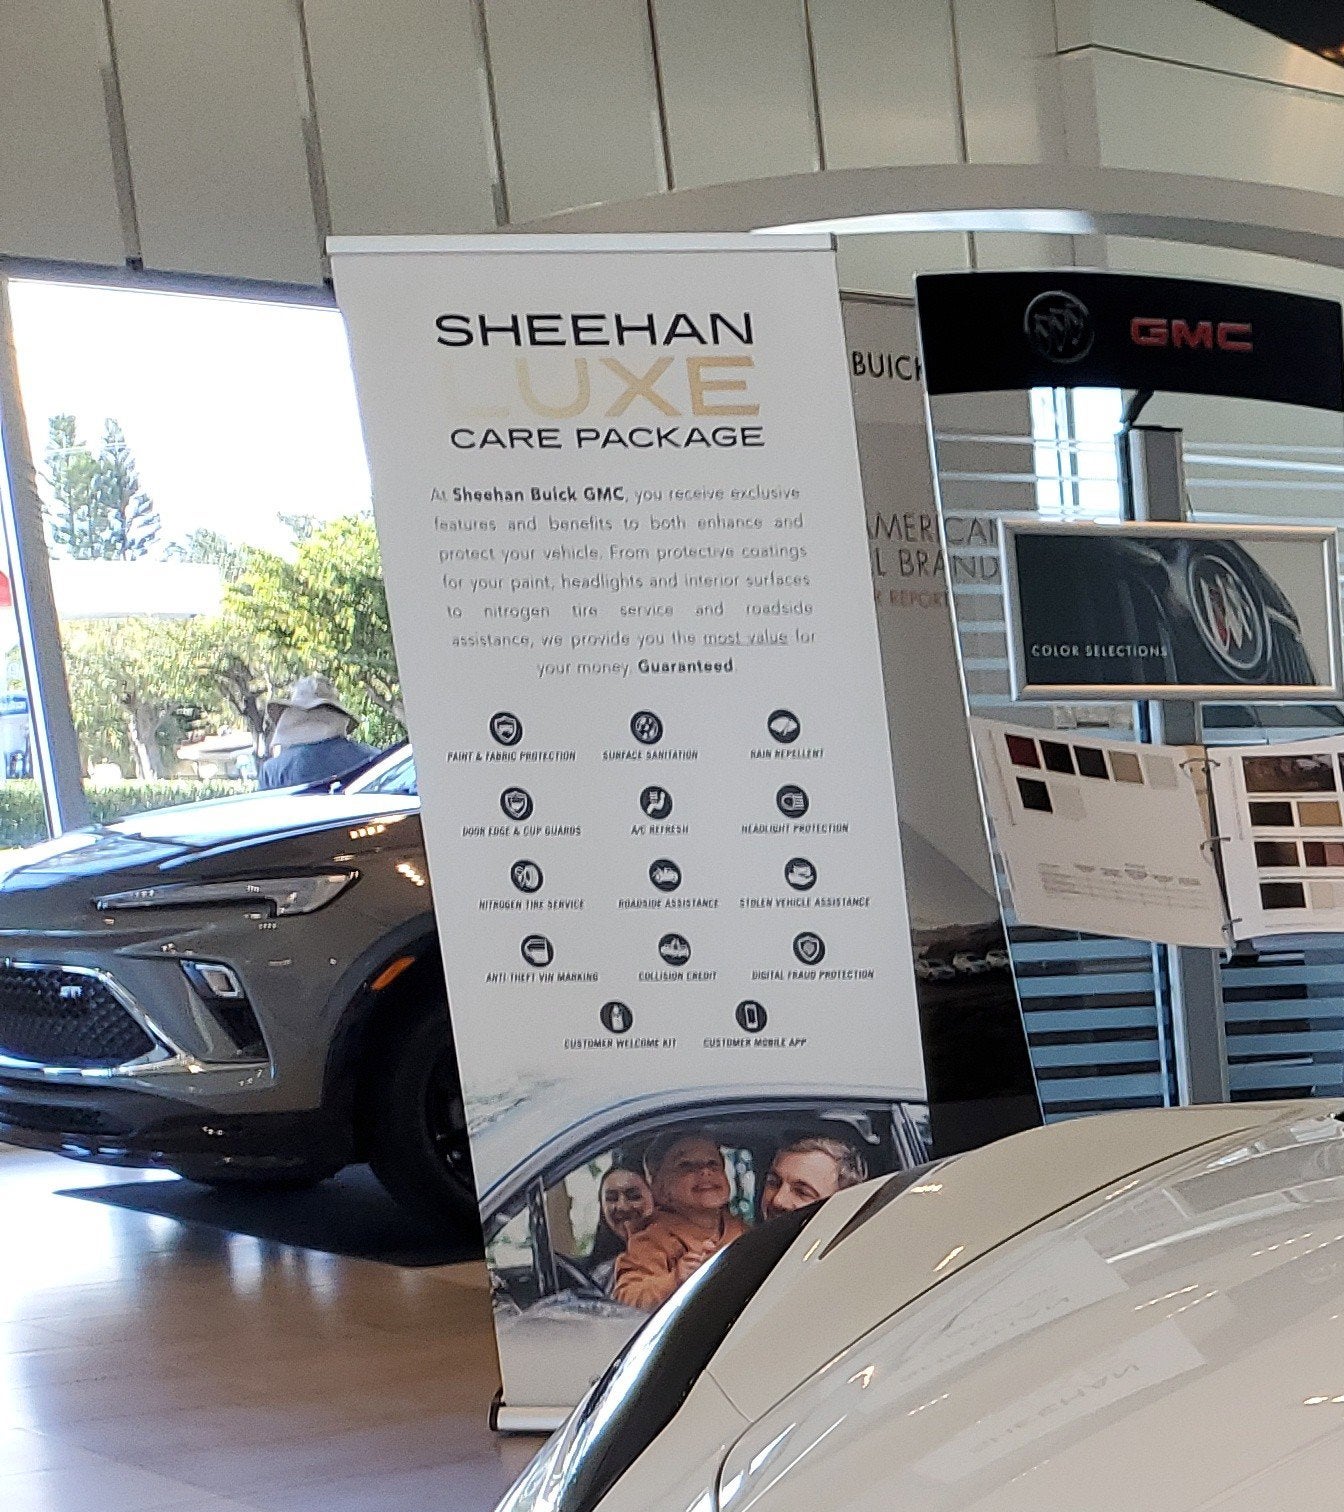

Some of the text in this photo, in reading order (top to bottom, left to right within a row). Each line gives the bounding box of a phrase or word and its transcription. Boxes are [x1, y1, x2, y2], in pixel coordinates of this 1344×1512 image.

[436, 312, 753, 347] SHEEHAN
[1130, 317, 1253, 351] GMC
[442, 356, 760, 419] LUXE
[451, 427, 765, 449] CARE PACKAGE
[452, 486, 525, 503] Sheehan
[530, 485, 578, 502] Buick
[634, 489, 663, 506] you
[668, 487, 725, 503] receive
[730, 484, 801, 501] exclusive
[433, 512, 804, 532] features and benefits to both enhance and
[438, 547, 496, 564] protect
[501, 548, 535, 565] your
[609, 544, 650, 560] From
[656, 545, 735, 563] protective
[741, 545, 808, 563] coatings
[442, 573, 463, 590] for
[470, 578, 503, 593] your
[560, 571, 644, 592] headlights
[649, 571, 678, 589] and
[684, 573, 740, 588] interior
[745, 570, 811, 588] surfaces
[446, 599, 813, 623] to nitrogen tire service and roadside
[541, 635, 563, 647] we
[570, 630, 631, 650] provide
[637, 634, 665, 650] you
[671, 629, 696, 646] the
[702, 630, 744, 647] most
[746, 628, 789, 647] value
[795, 627, 815, 644] for
[1031, 644, 1168, 658] COLOR SELECTIONS
[536, 662, 572, 679] your
